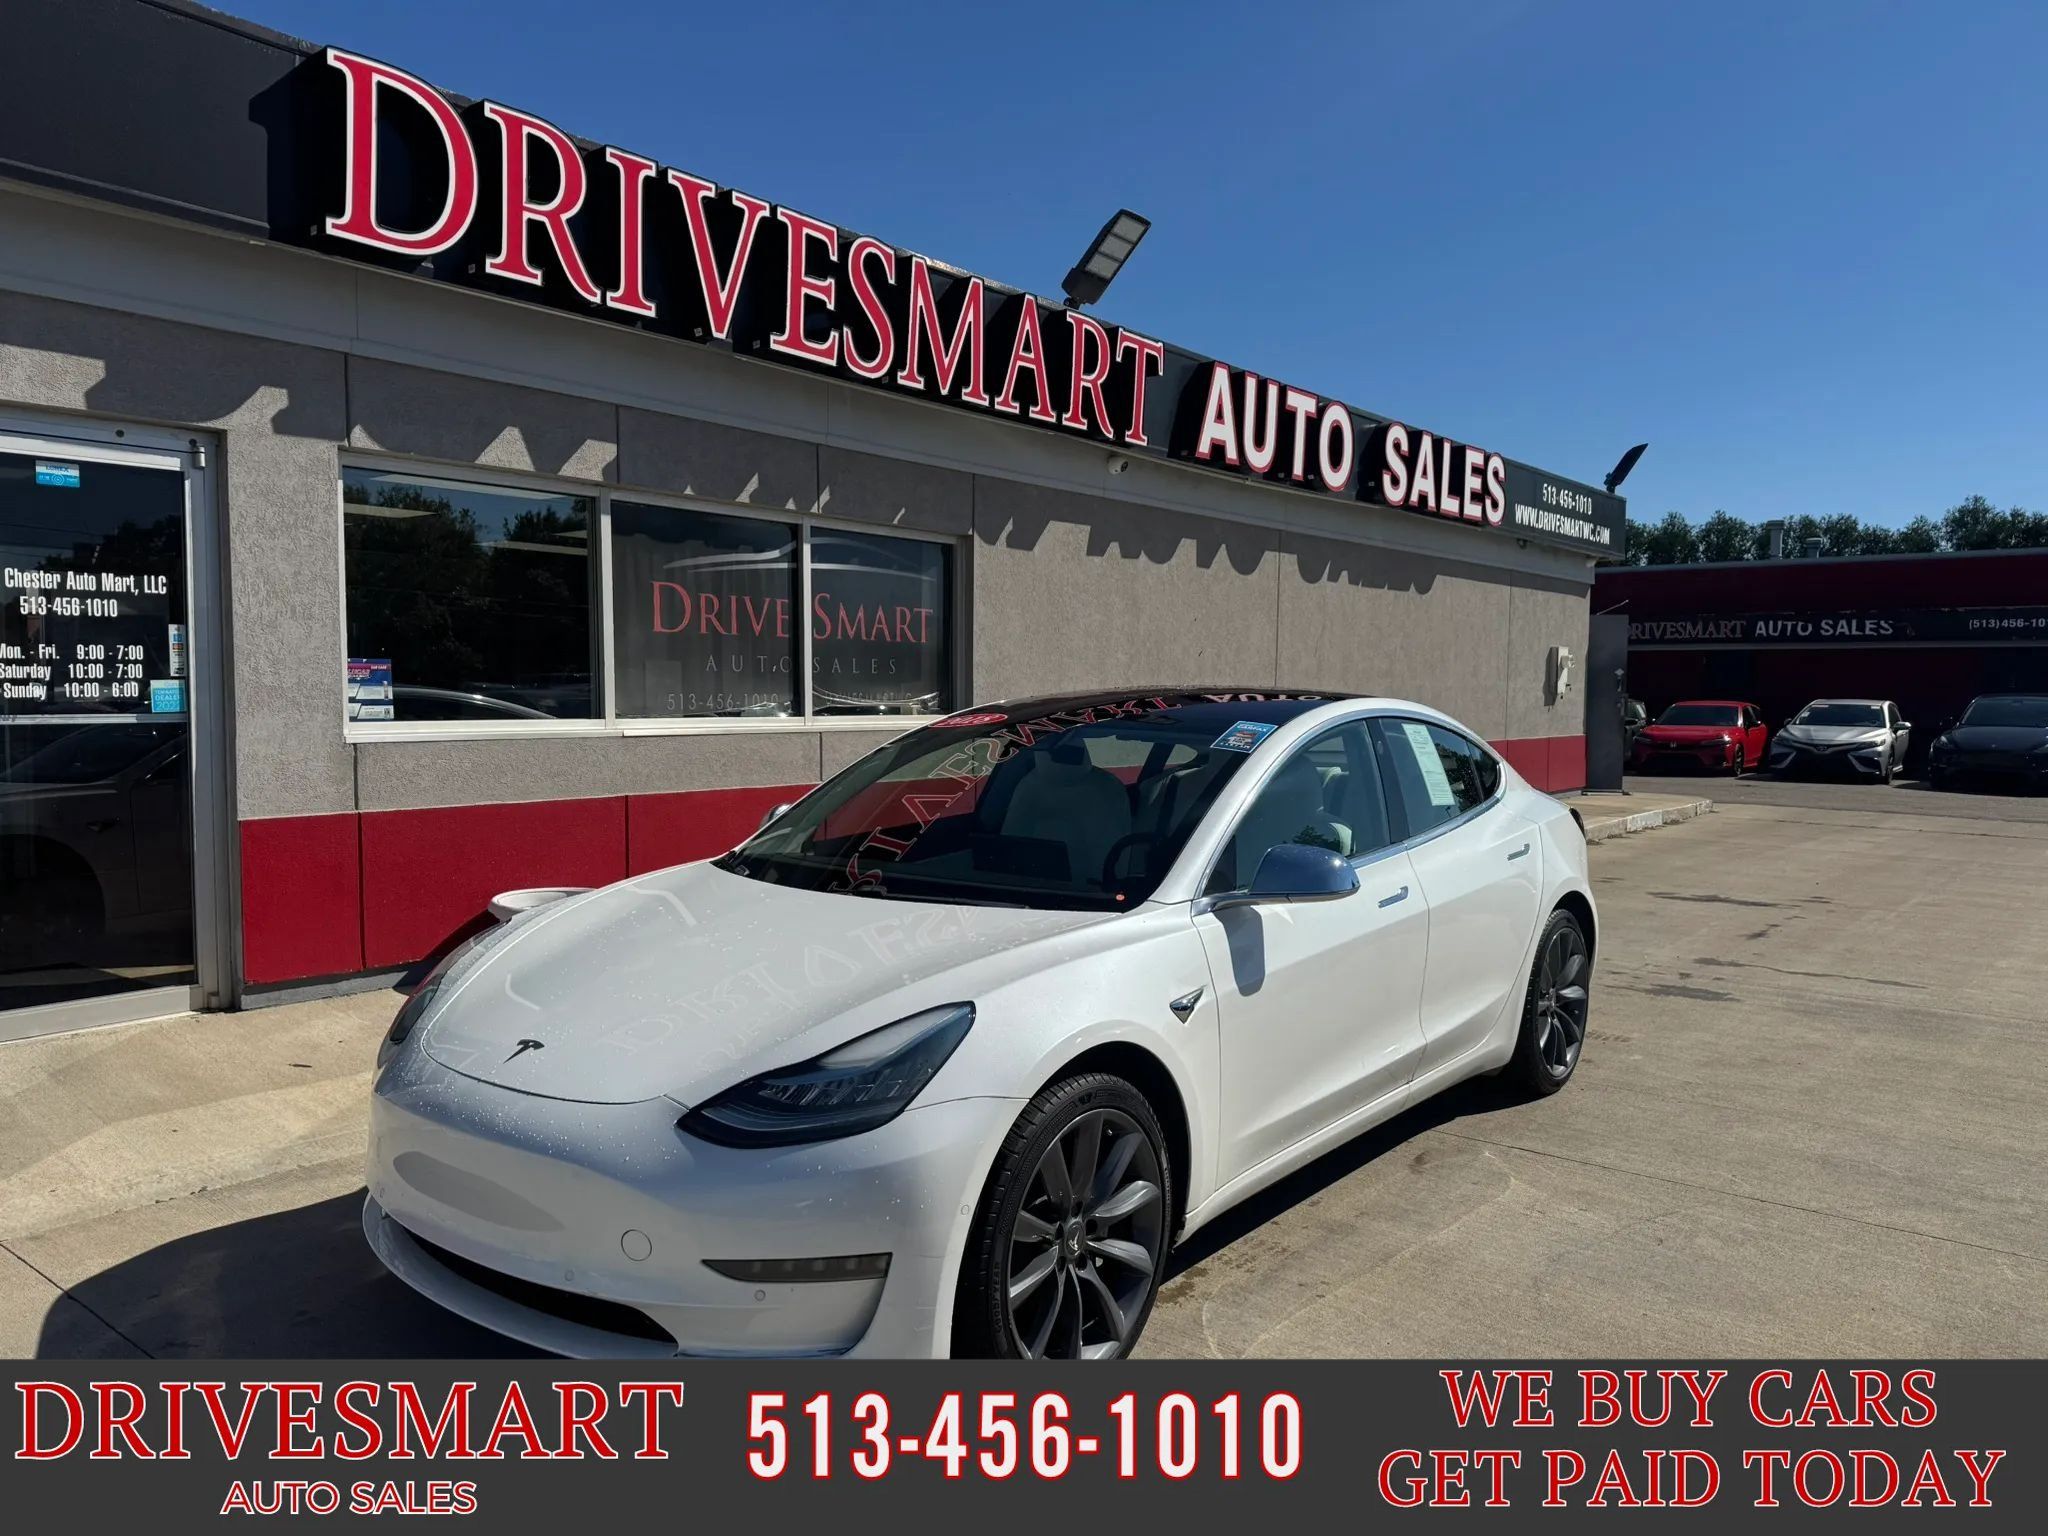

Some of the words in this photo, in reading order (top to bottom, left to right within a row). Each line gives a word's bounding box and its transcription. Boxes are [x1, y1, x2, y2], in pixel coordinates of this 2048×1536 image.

[326, 46, 1164, 447] DRIVESMART
[1196, 360, 1354, 492] AUTO
[1382, 422, 1506, 527] SALES
[1542, 483, 1592, 515] 513-456-1010
[1515, 503, 1610, 545] WWW.DRIVESMARTWC.COM
[4, 567, 61, 590] Chester
[66, 571, 97, 592] Auto
[101, 573, 139, 596] Mart,
[144, 575, 167, 595] LLC
[20, 596, 118, 618] 513-456-1010
[651, 580, 789, 638] DRIVE
[813, 592, 933, 644] SMART
[1755, 619, 1812, 637] AUTO
[1820, 618, 1893, 637] SALES
[38, 643, 60, 660] Fri.
[76, 644, 105, 660] 9:00
[116, 645, 144, 660] 7:00
[0, 663, 52, 681] Saturday
[68, 663, 104, 679] 10:00
[116, 664, 143, 679] 7:00
[813, 657, 896, 674] SALES
[3, 682, 48, 701] Sunday
[64, 682, 100, 698] 10:00
[112, 683, 139, 698] 6:00
